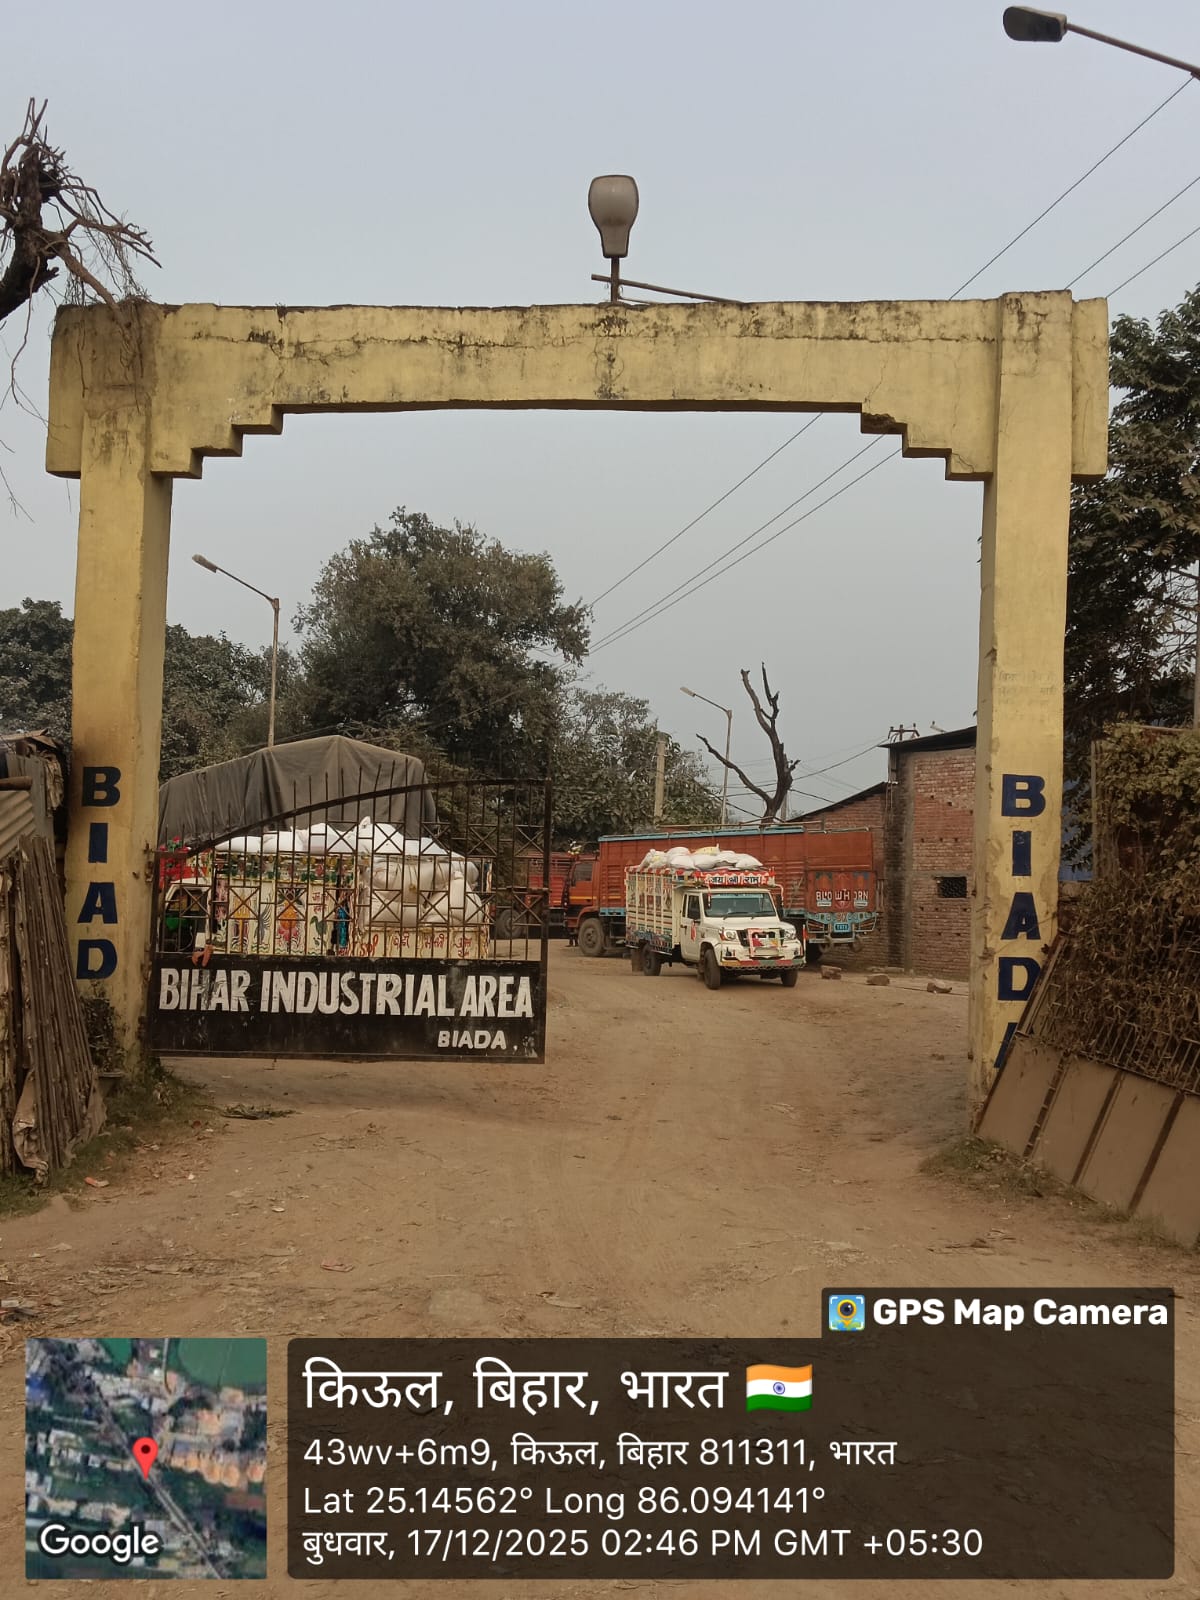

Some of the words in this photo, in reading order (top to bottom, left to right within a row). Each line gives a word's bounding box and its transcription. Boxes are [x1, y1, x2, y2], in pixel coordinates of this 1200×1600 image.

[159, 968, 250, 1012] BIHAR
[260, 970, 456, 1018] INDUSTRIAL
[459, 975, 533, 1018] AREA
[437, 1030, 507, 1050] BIADA
